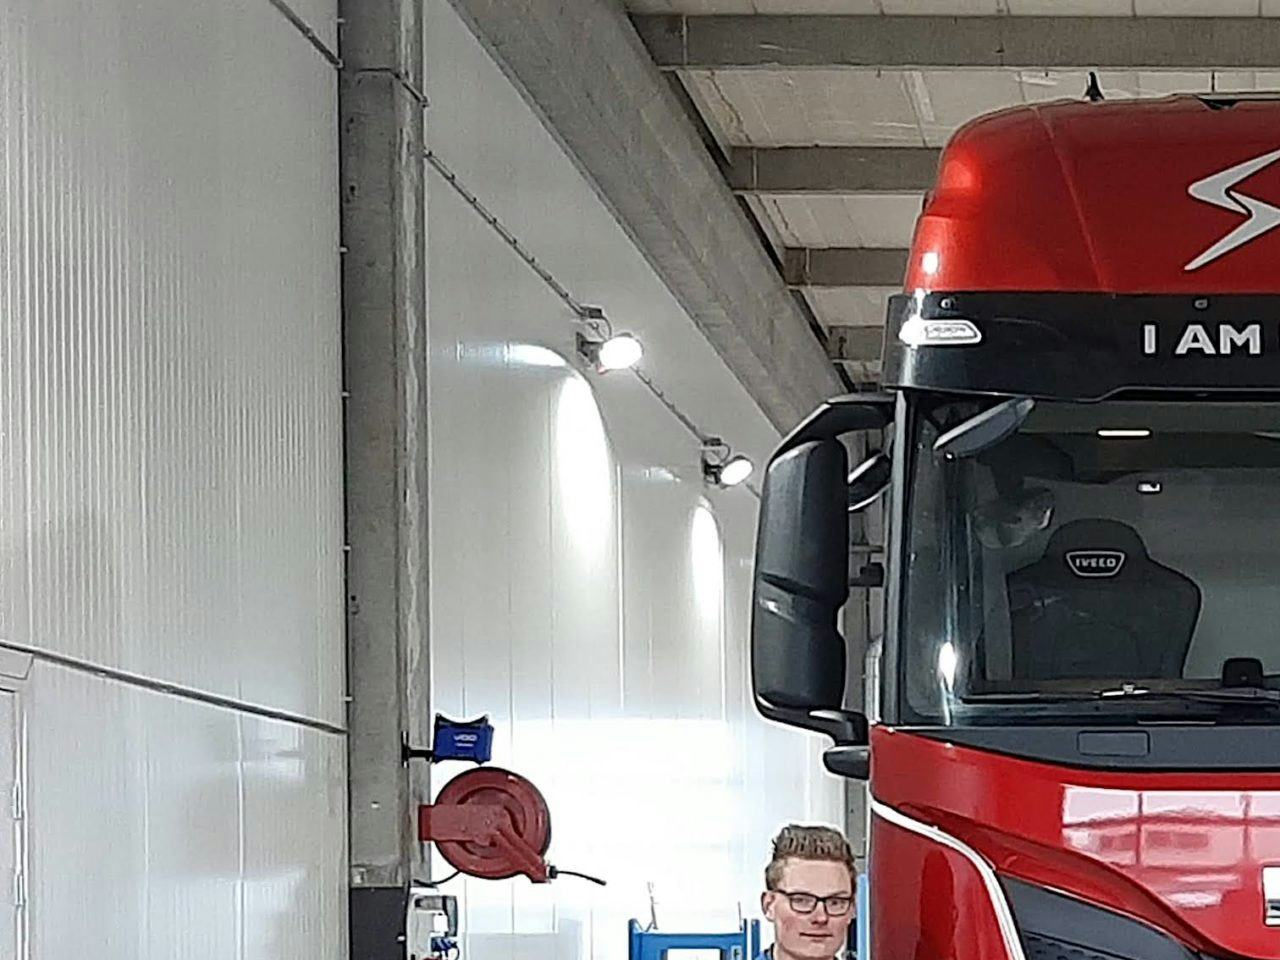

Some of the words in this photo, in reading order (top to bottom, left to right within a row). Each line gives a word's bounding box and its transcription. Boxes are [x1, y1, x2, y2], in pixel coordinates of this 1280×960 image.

[1143, 323, 1156, 354] I
[1175, 323, 1261, 355] AM
[1075, 557, 1117, 568] IVECO
